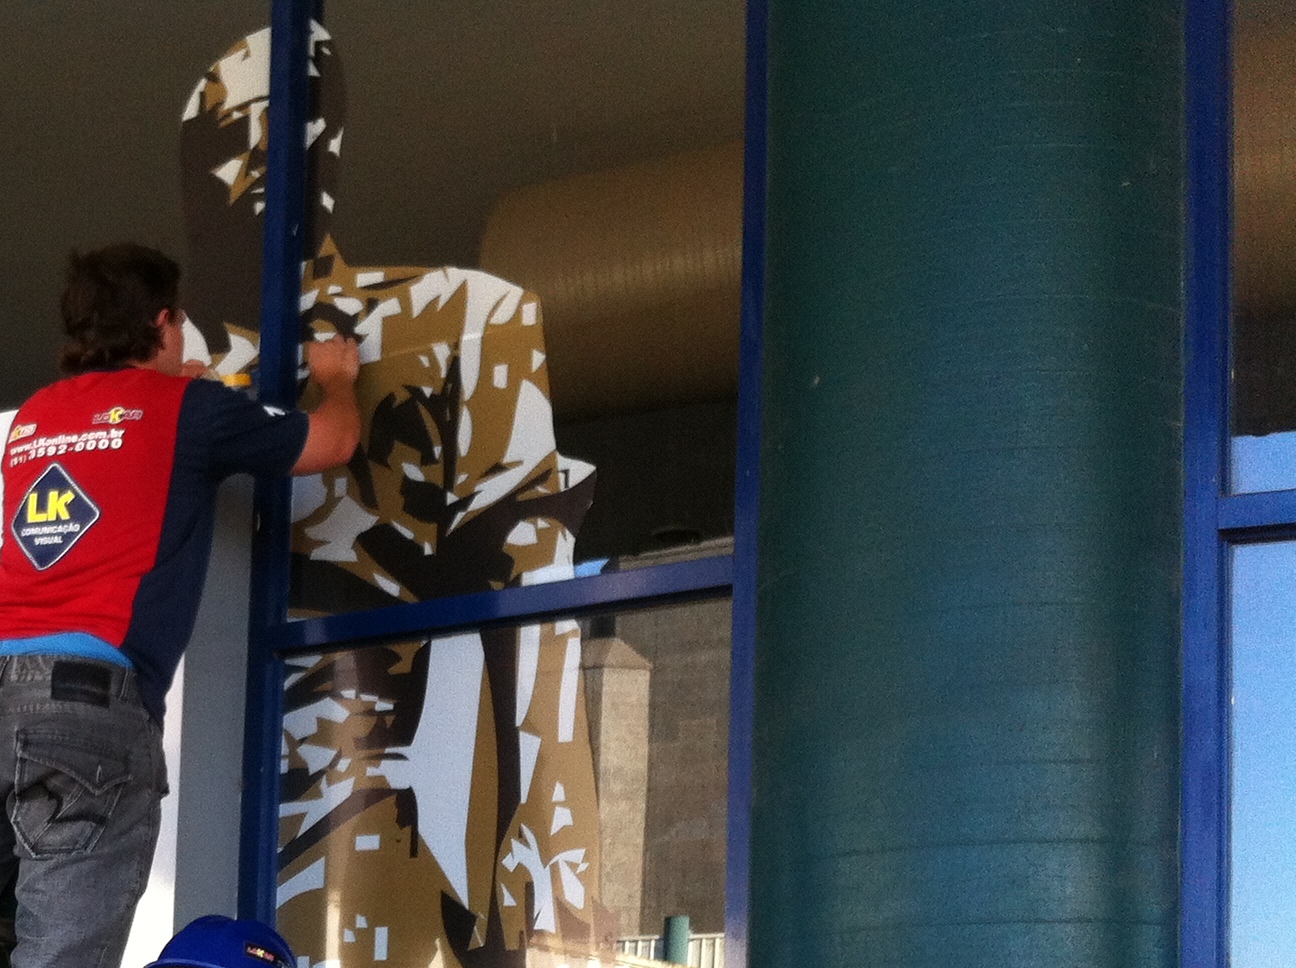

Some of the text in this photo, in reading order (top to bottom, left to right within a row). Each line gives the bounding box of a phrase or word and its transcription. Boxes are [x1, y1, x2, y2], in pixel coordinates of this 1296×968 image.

[28, 438, 123, 460] 3592-0000
[27, 489, 75, 523] LK
[34, 535, 63, 546] VISUAL
